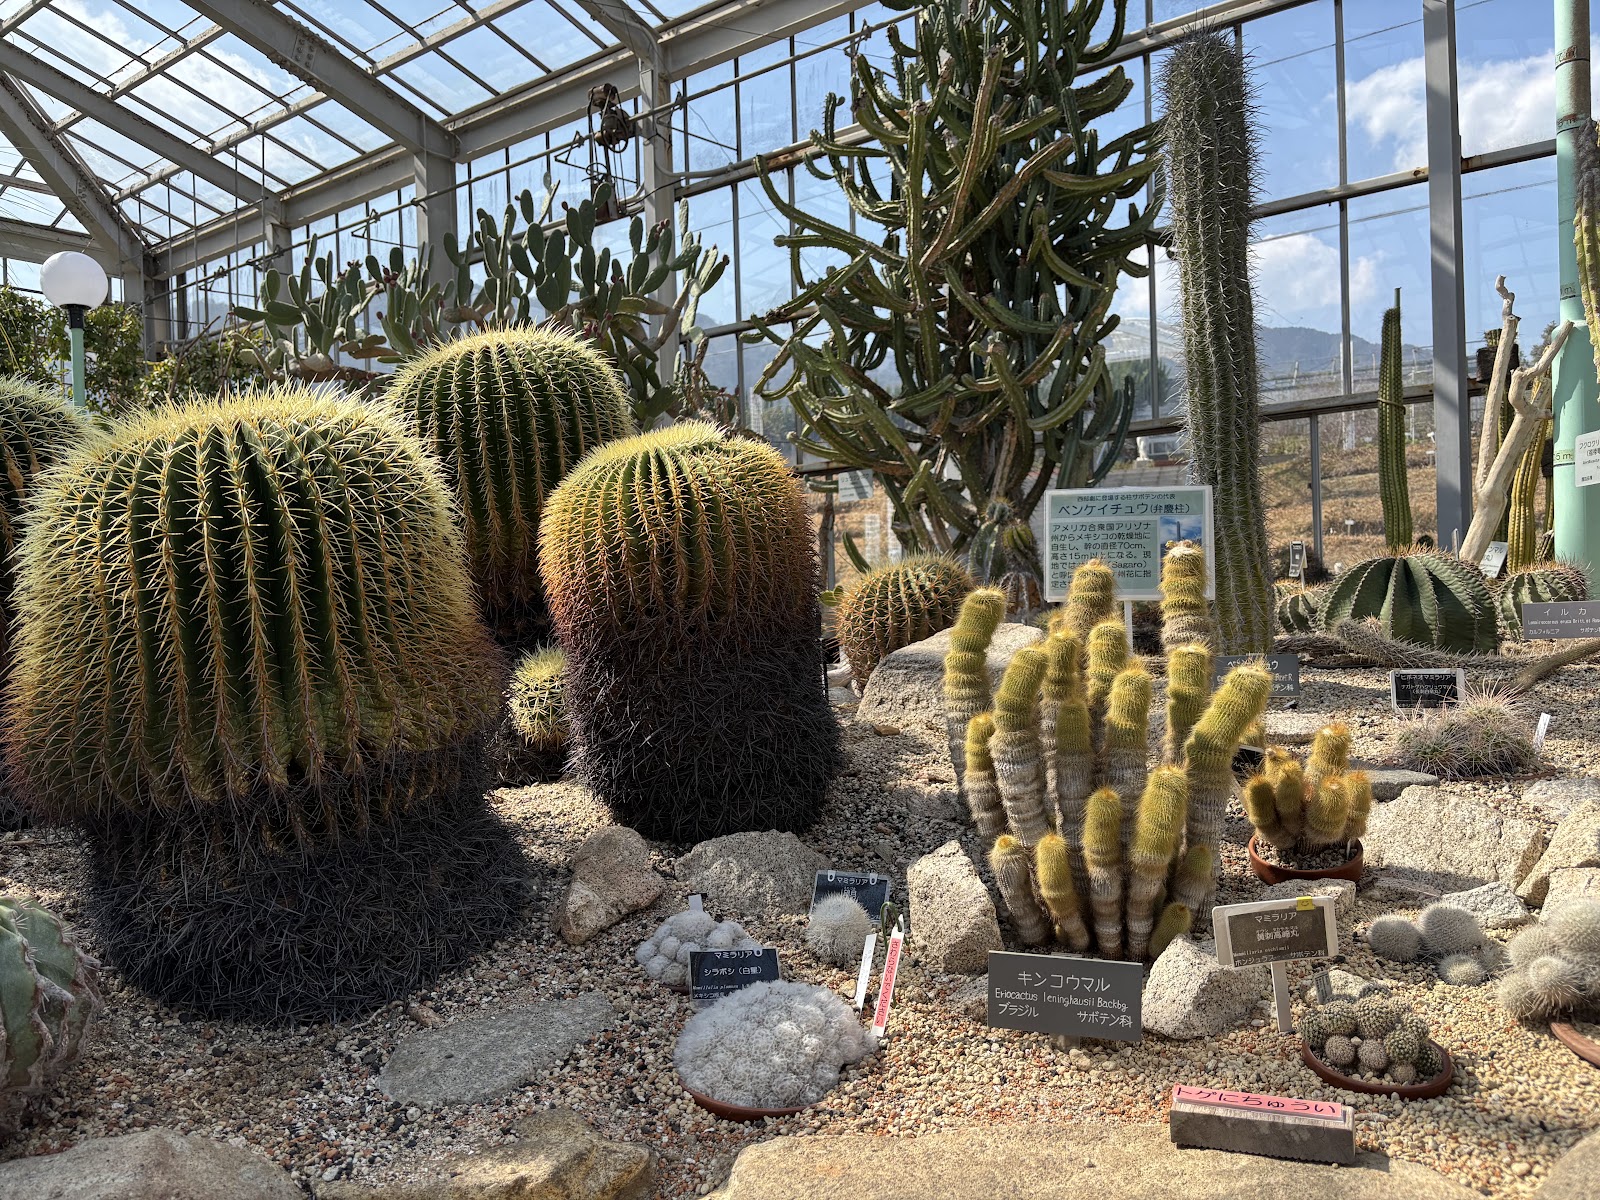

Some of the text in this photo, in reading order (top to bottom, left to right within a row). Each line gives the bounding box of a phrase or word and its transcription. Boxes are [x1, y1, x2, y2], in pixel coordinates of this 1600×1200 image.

[1052, 522, 1151, 532] アメリカ合衆国アリゾナ
[1051, 532, 1151, 541] 州からメキシコの乾燥地に
[836, 877, 868, 886] マミラリア
[1254, 911, 1297, 923] マミラリア
[714, 950, 753, 959] マミラリア
[1017, 970, 1111, 993] キンコウマル
[995, 988, 1038, 1001] Eriocactus
[998, 1002, 1133, 1028] ブラジル サボテン科
[1177, 1086, 1336, 1113] トゲにちゅうい
